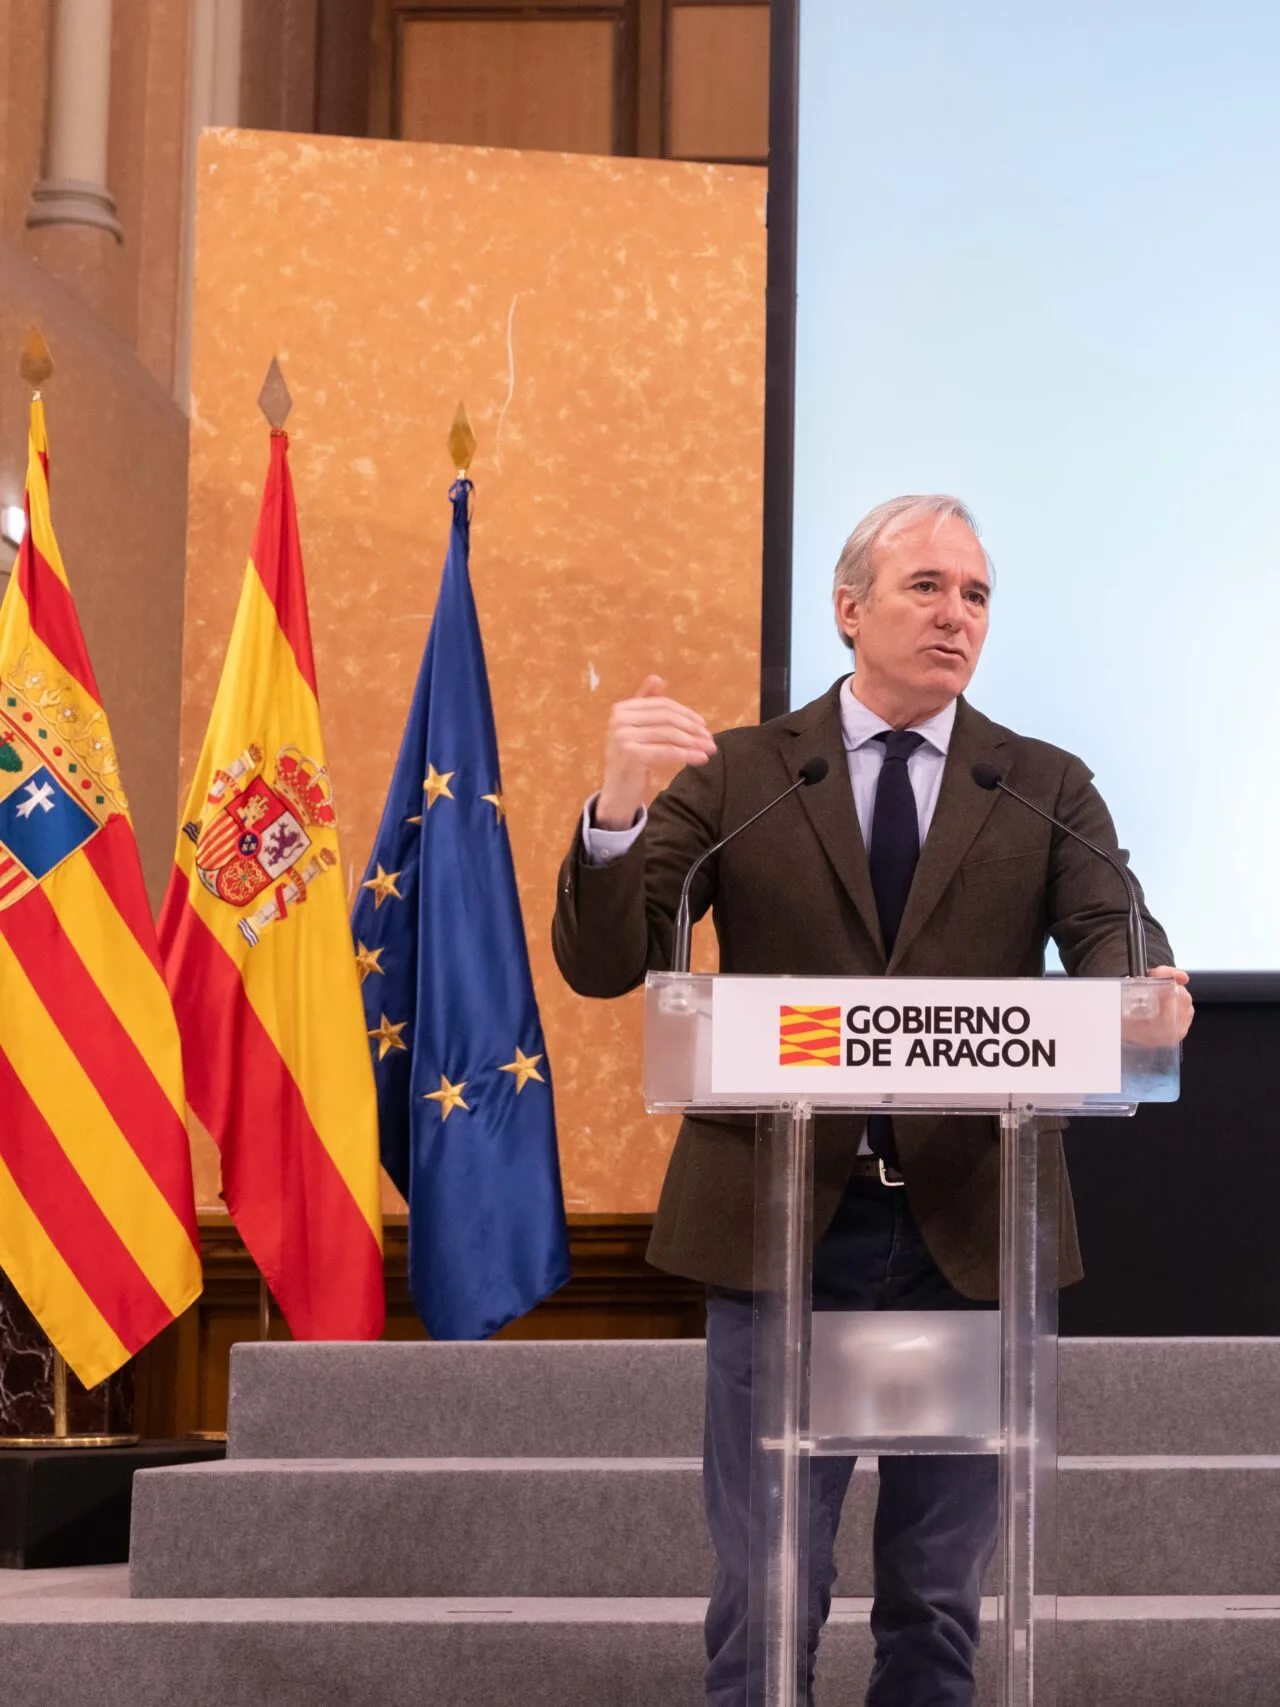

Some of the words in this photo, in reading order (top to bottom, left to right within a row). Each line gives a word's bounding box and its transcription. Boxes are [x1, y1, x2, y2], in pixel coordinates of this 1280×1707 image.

[846, 1005, 1031, 1035] GOBIERNO
[846, 1038, 892, 1067] DE
[905, 1038, 1056, 1067] ARAGON
